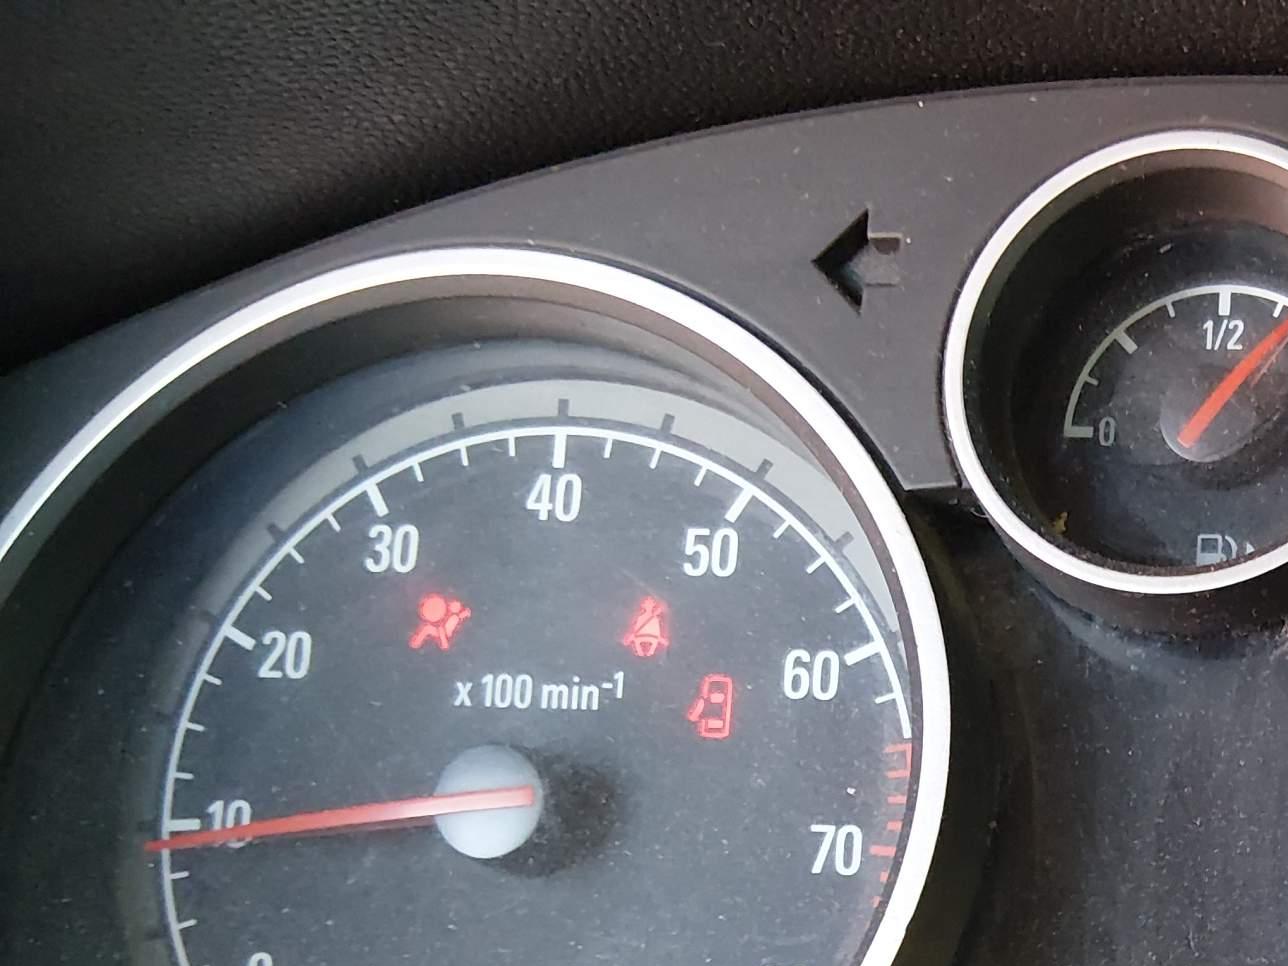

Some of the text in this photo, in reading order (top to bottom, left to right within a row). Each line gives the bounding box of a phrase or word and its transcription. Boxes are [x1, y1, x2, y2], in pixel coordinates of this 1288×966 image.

[1202, 319, 1244, 351] 1/2
[1099, 417, 1115, 447] 0
[525, 475, 581, 523] 40
[364, 525, 419, 574] 30
[683, 527, 739, 577] 50
[257, 631, 312, 680] 20
[783, 651, 839, 701] 60
[454, 682, 472, 707] x
[480, 675, 532, 710] 100
[809, 825, 862, 876] 70
